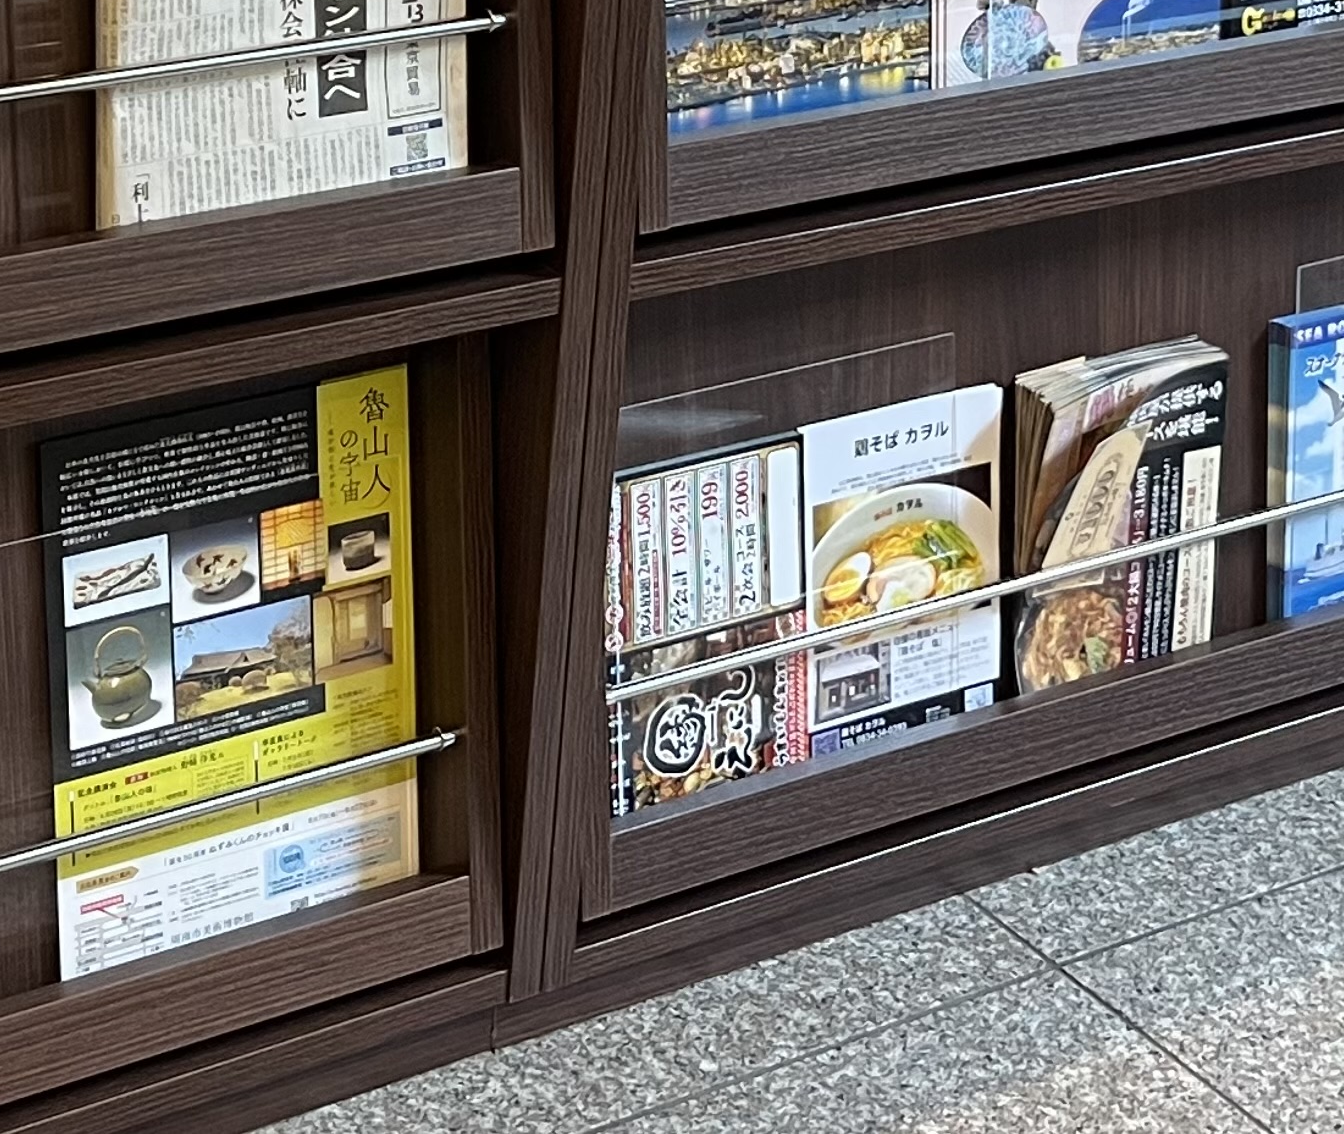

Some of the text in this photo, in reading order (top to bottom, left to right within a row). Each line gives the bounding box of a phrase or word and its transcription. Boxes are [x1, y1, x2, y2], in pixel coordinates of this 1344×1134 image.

[1293, 325, 1323, 344] SEA
[854, 420, 950, 458] 鶏そば カヲル
[340, 429, 361, 505] の宇宙
[701, 482, 718, 520] 199
[669, 479, 688, 627] 全会計 10%引き
[736, 524, 744, 562] コース
[738, 561, 756, 604] 2次会
